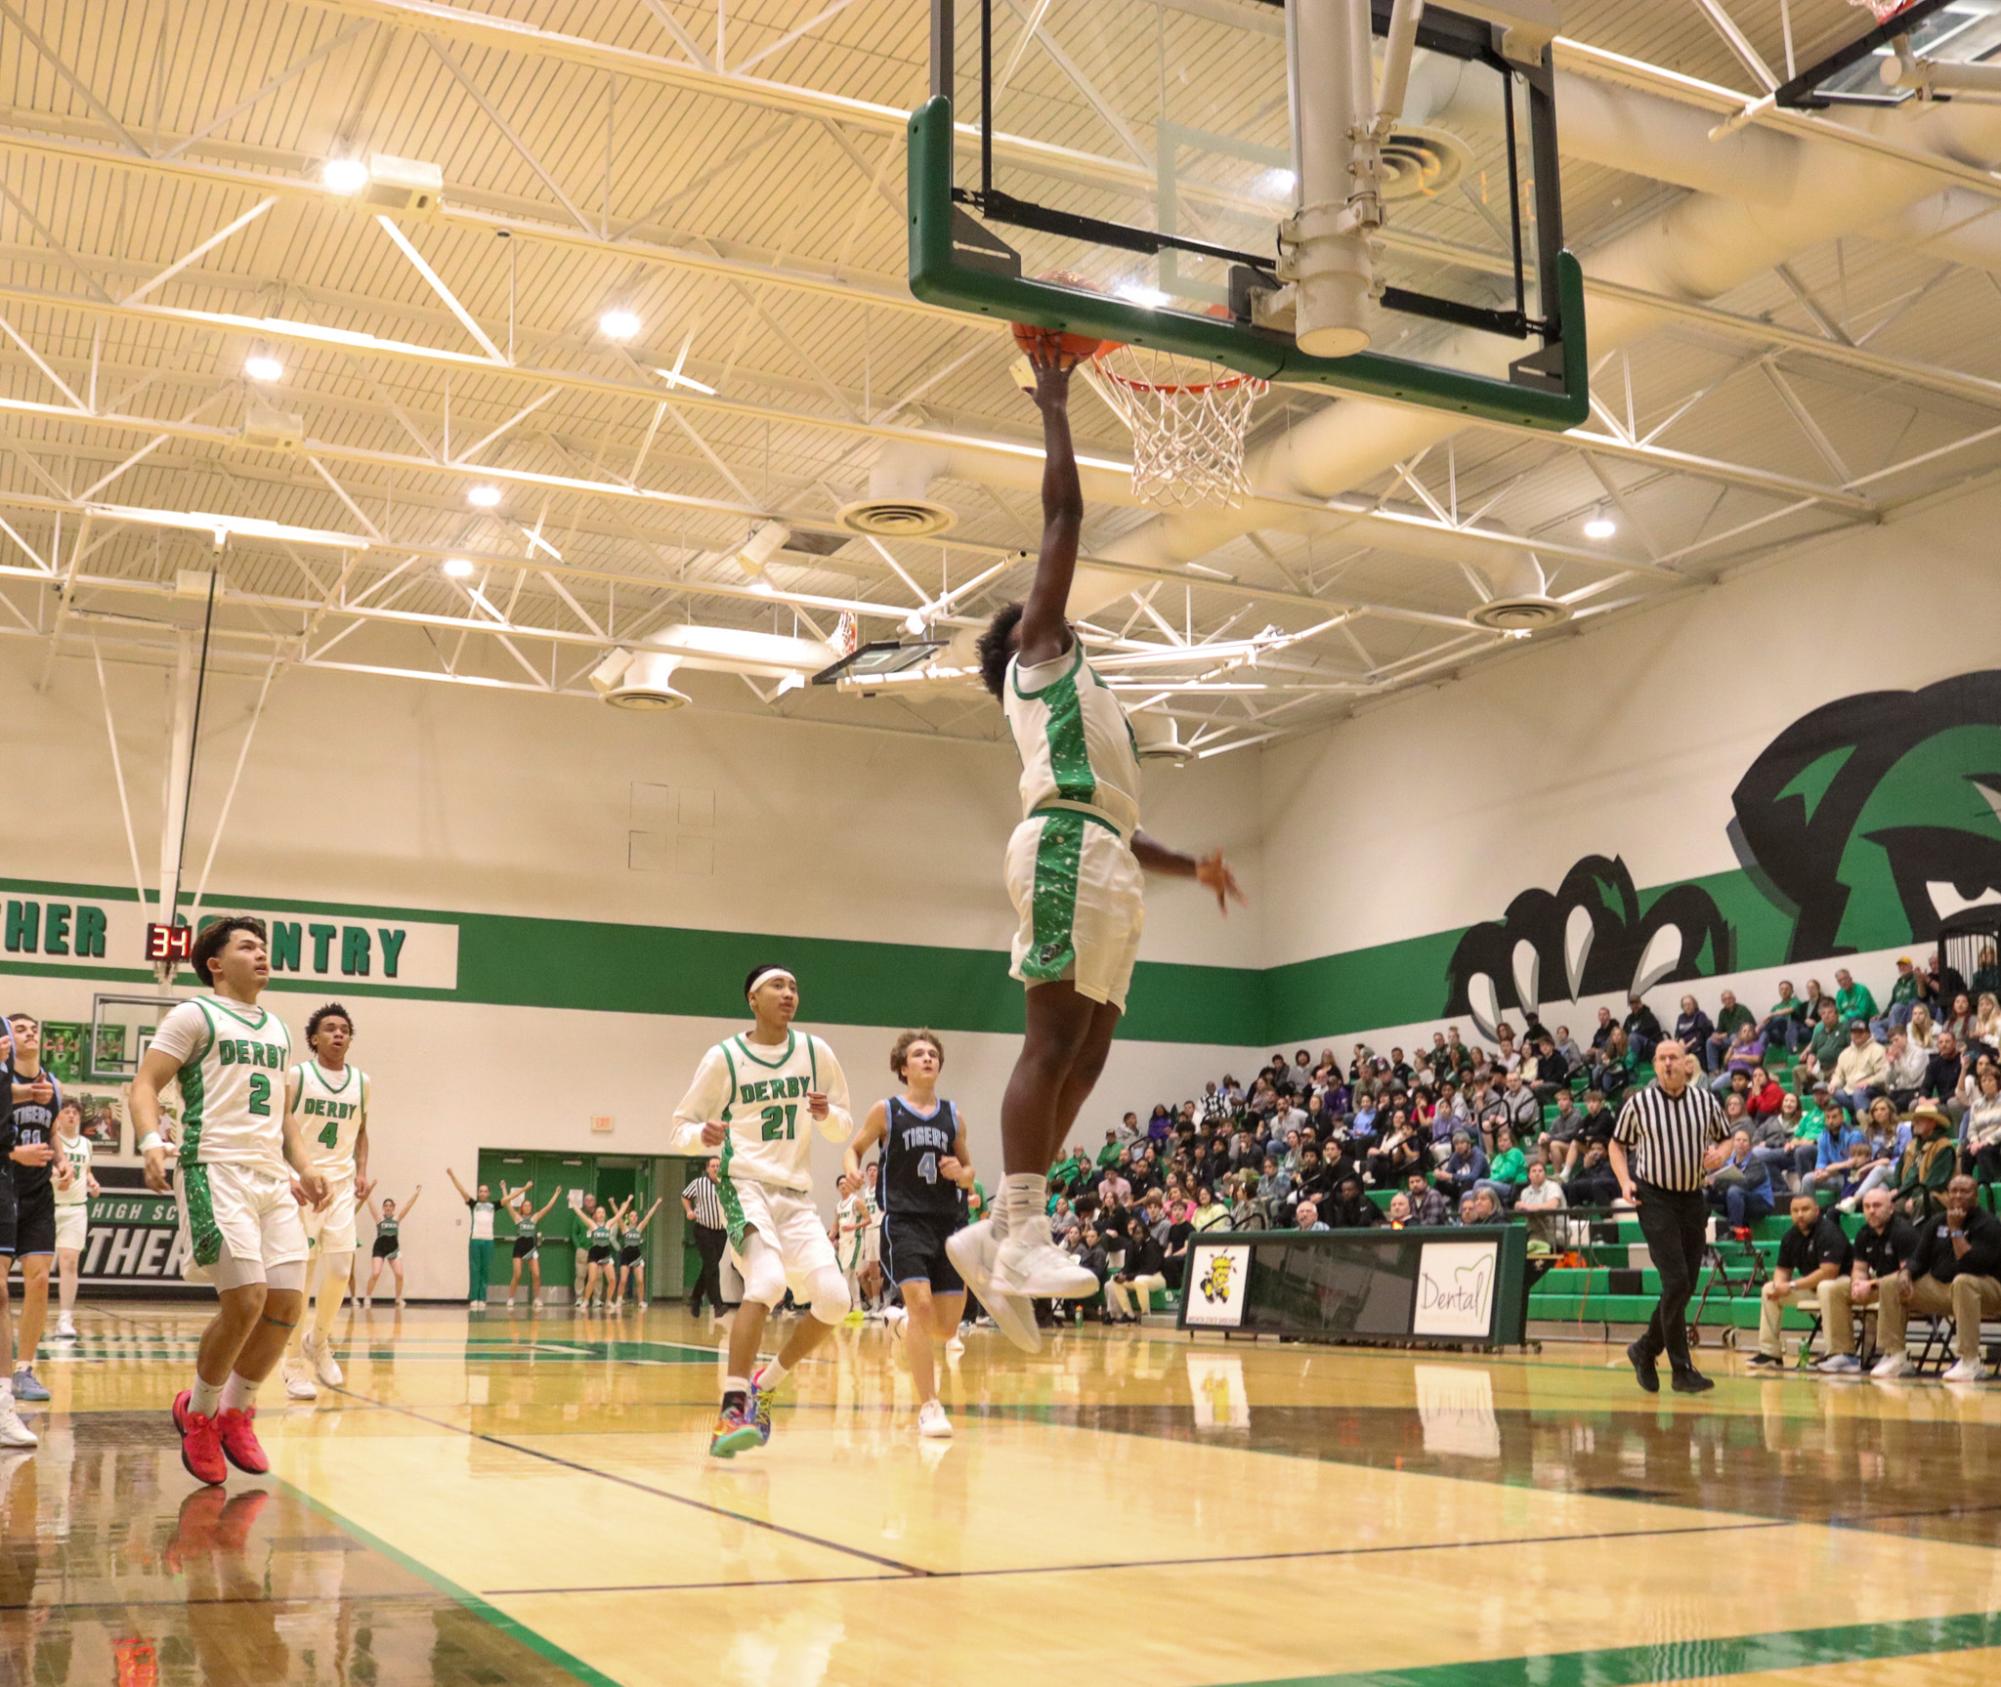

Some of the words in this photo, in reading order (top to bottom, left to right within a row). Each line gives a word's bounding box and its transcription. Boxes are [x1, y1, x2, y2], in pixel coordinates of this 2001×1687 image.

[0, 900, 108, 958] HER
[152, 926, 188, 957] 34
[219, 1039, 287, 1072] DERBY
[249, 1072, 271, 1117] 2
[740, 1076, 811, 1104] DERBY
[304, 1098, 357, 1121] DERBY
[760, 1104, 798, 1142] 21
[318, 1121, 339, 1150] 4
[901, 1127, 949, 1151] TIGERS
[917, 1151, 938, 1185] 4
[91, 1202, 143, 1220] HIGH
[151, 1204, 178, 1221] SC
[1421, 1271, 1484, 1319] Dental
